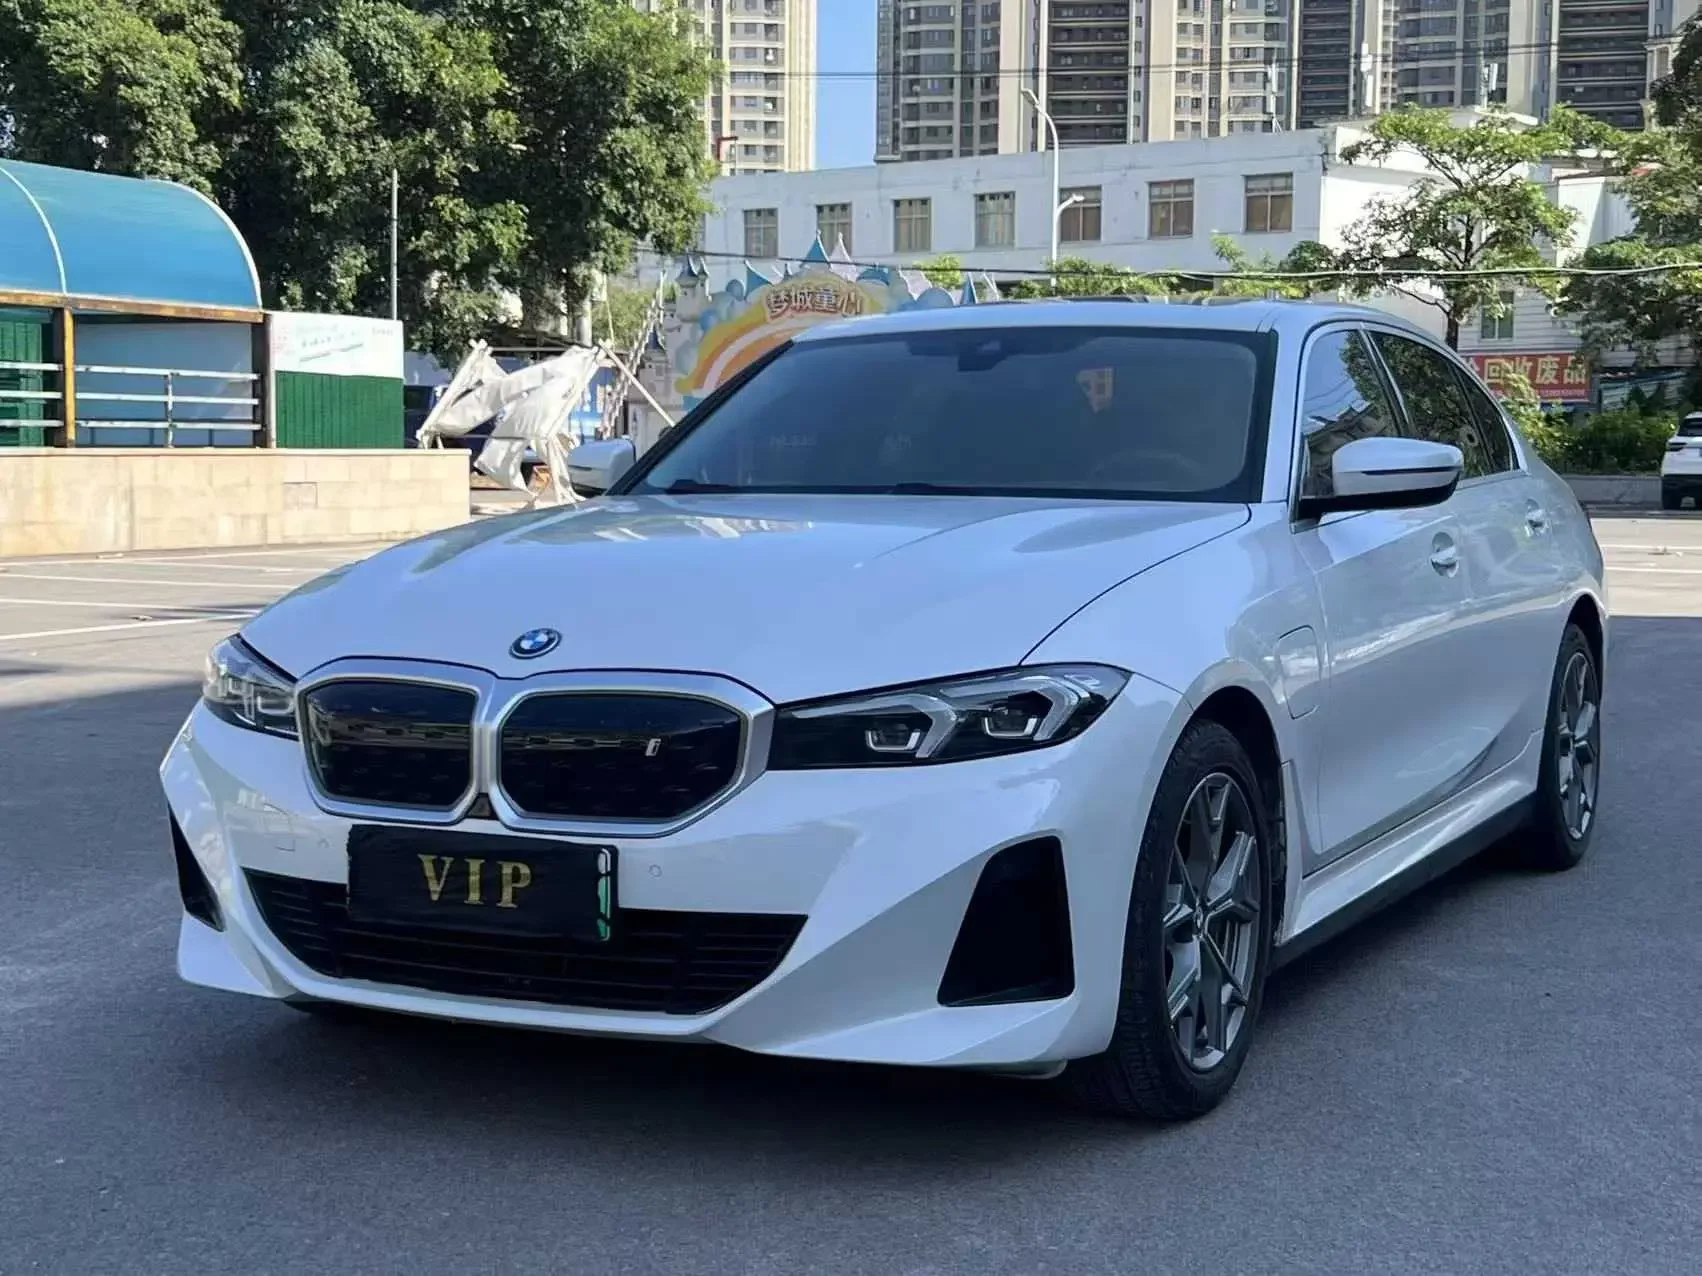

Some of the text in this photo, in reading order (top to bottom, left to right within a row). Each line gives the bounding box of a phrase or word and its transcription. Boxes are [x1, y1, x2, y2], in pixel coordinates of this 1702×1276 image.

[1463, 355, 1586, 385] 回收废品
[417, 853, 532, 909] VIP
